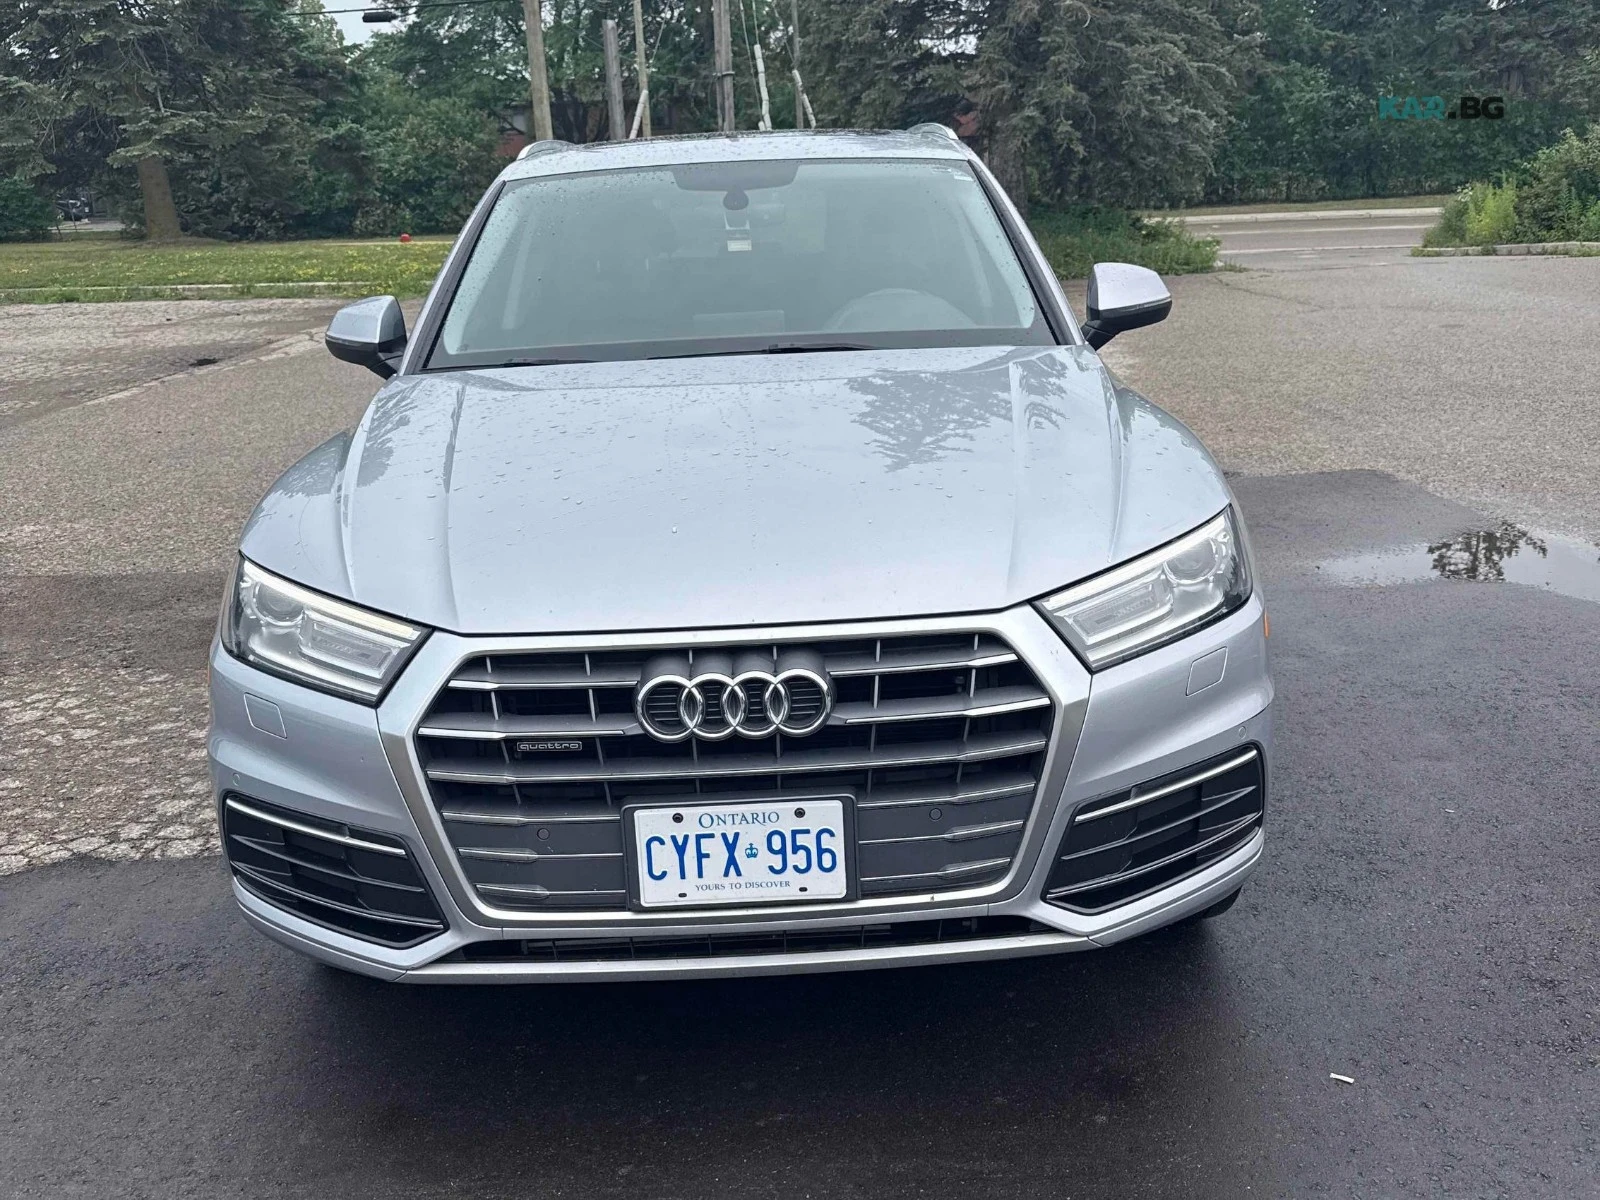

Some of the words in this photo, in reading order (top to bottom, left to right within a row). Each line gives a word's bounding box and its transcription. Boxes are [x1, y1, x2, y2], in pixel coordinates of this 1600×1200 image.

[519, 743, 579, 751] quattro
[698, 811, 780, 829] ONTARIO
[645, 831, 743, 881] CYFX
[766, 828, 838, 875] 956
[695, 883, 726, 892] YOURS
[729, 882, 742, 890] TO
[745, 880, 791, 889] DISCOVER
